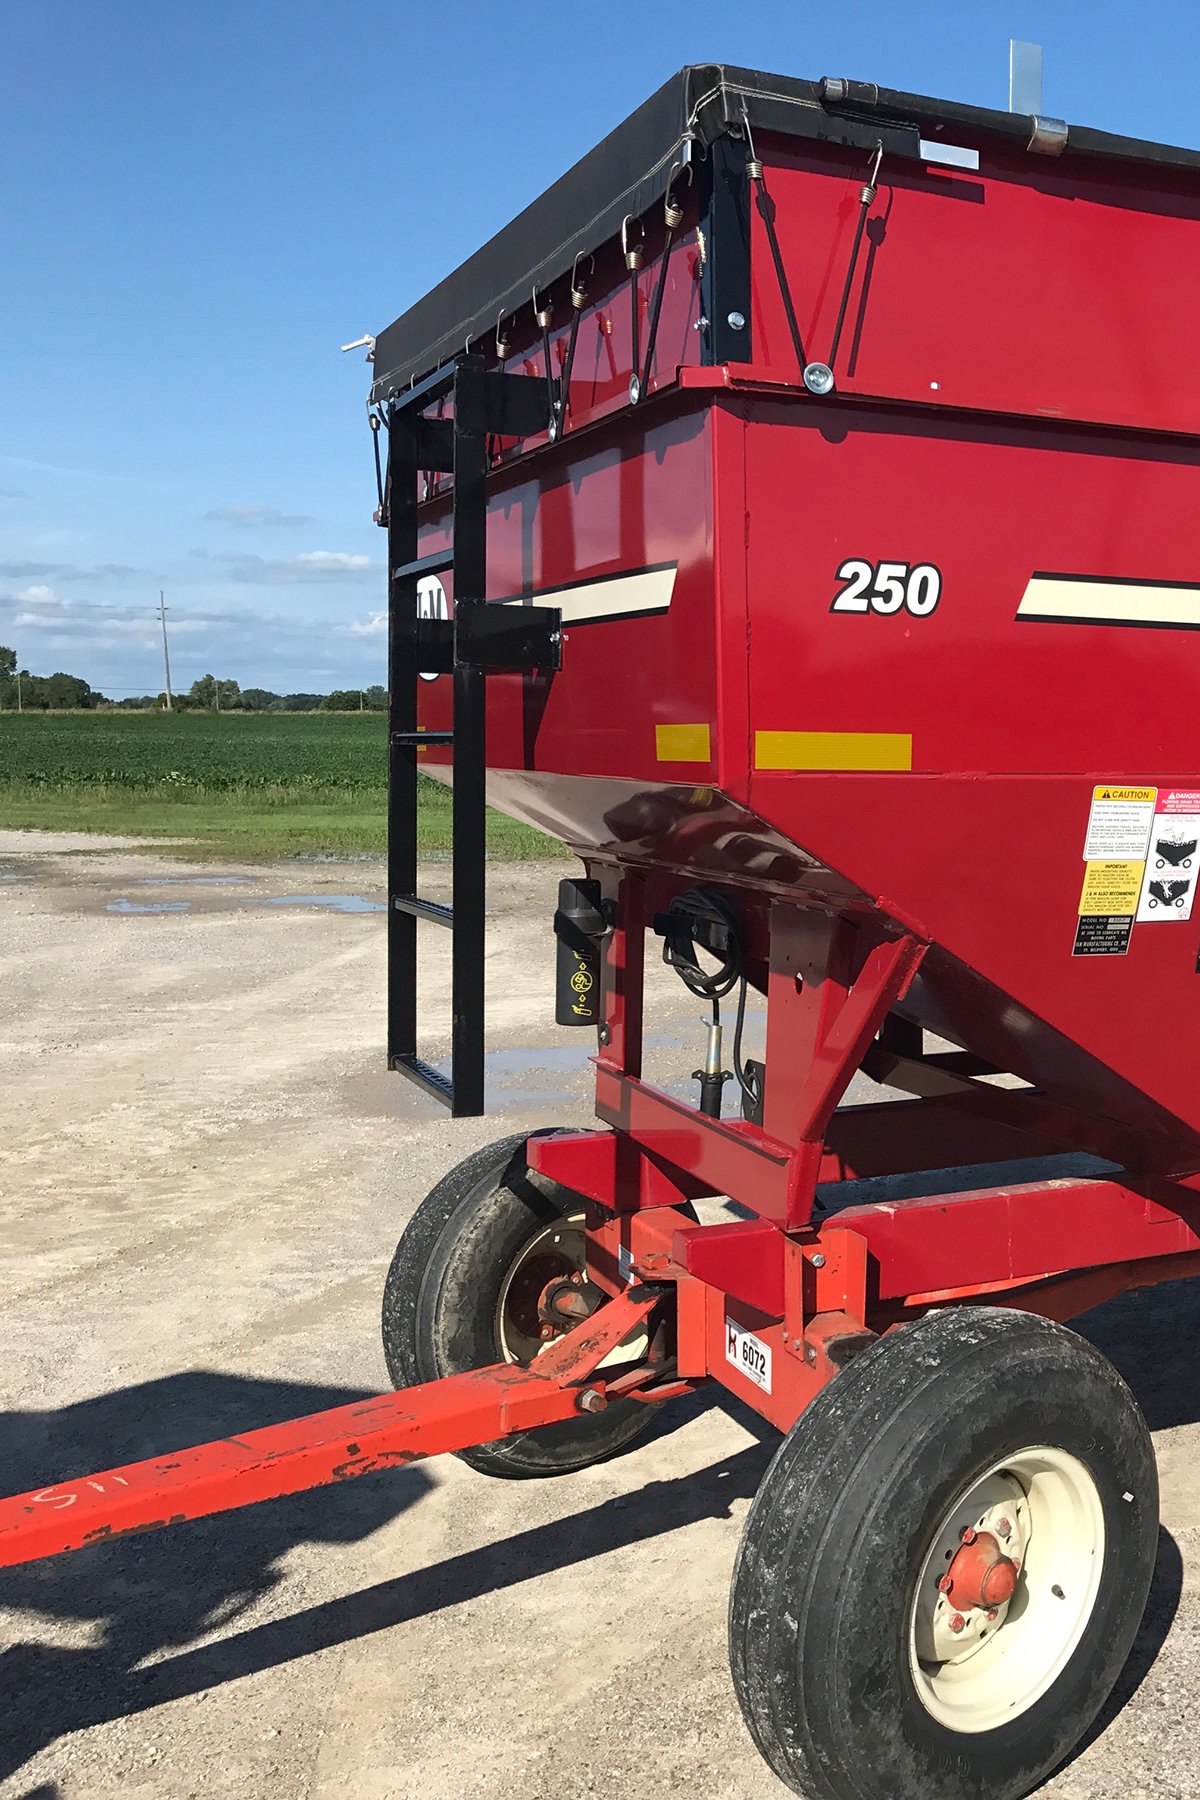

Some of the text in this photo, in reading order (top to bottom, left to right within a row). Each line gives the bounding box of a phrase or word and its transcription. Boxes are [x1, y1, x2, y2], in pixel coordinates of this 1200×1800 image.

[831, 558, 942, 617] 250
[1112, 790, 1150, 799] CAUTION
[742, 1341, 766, 1376] 6072
